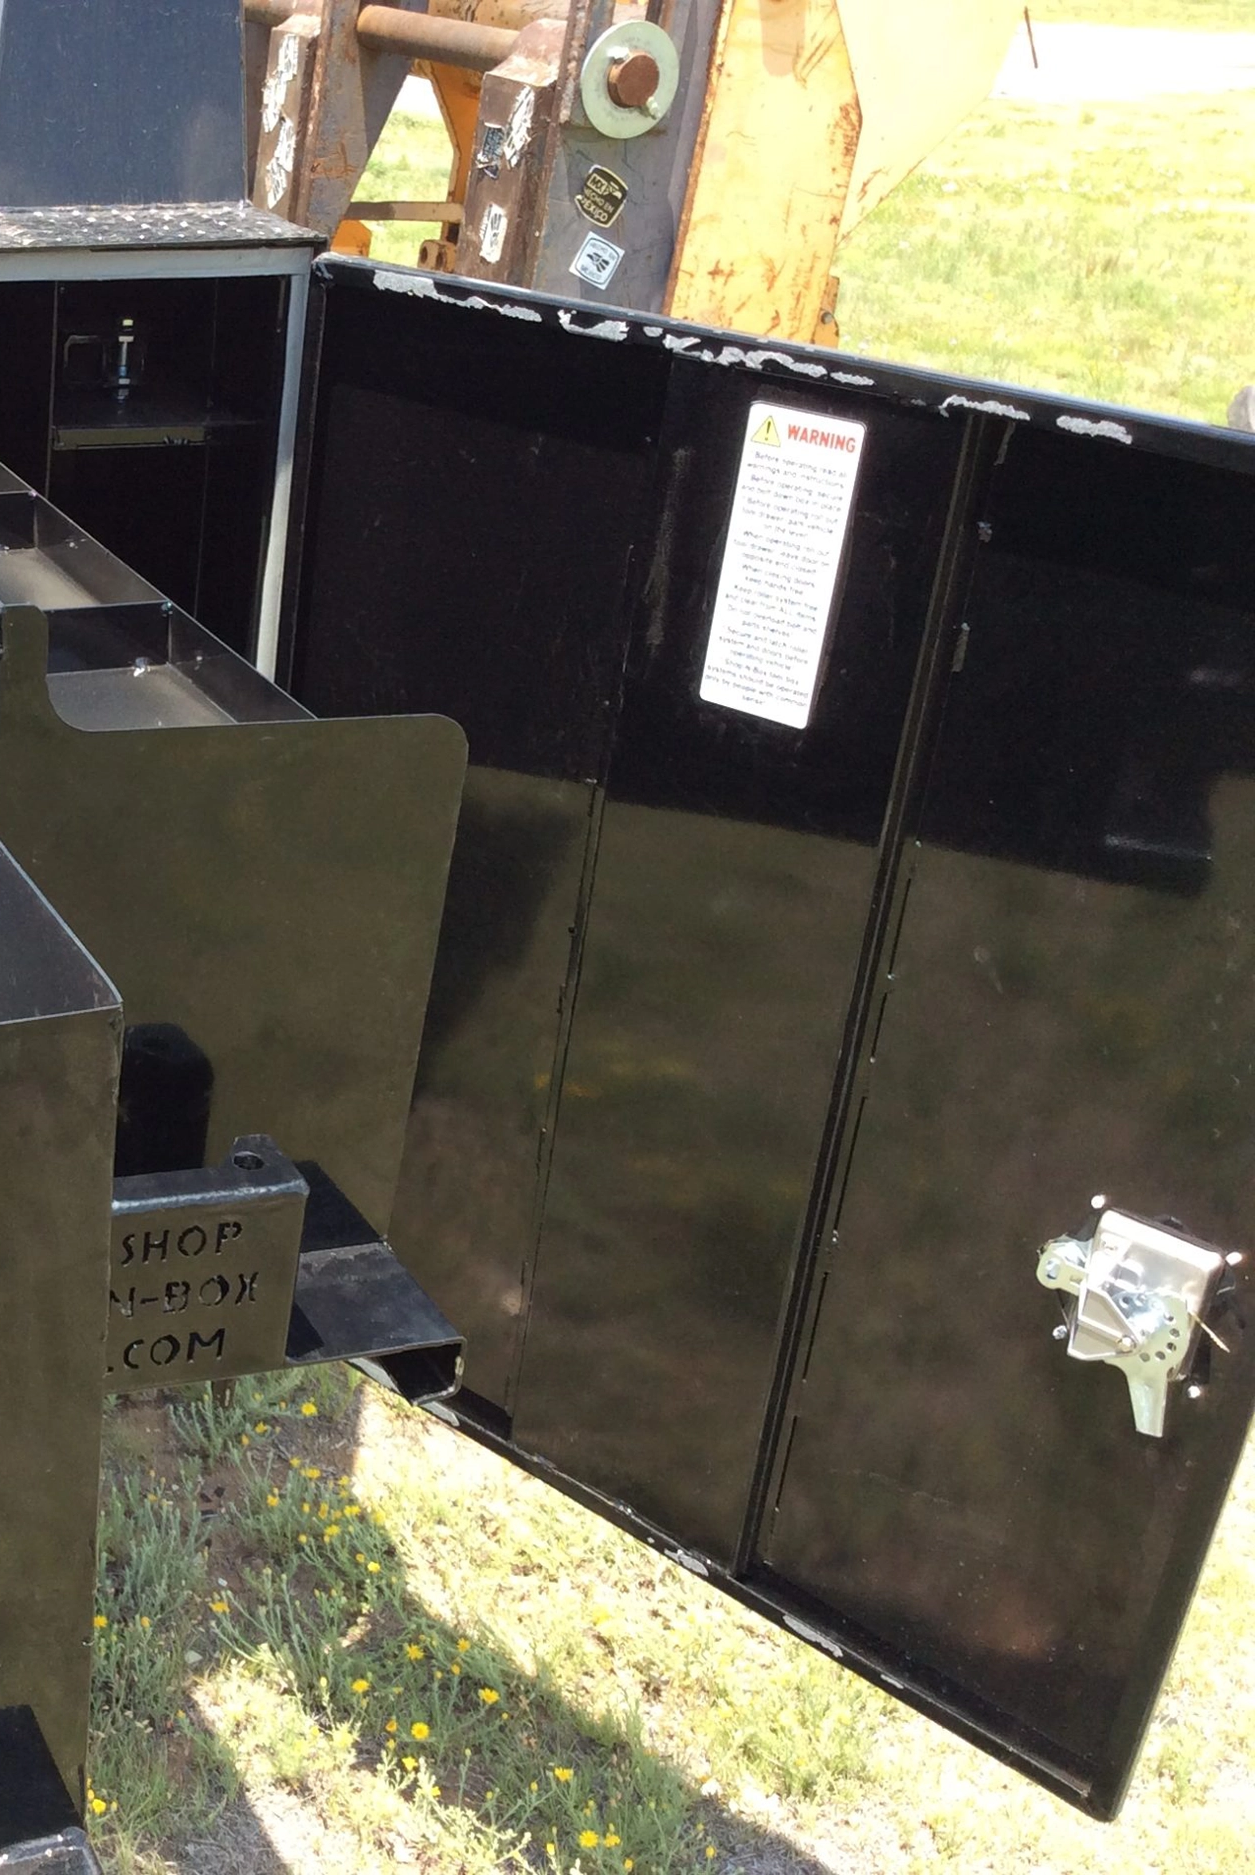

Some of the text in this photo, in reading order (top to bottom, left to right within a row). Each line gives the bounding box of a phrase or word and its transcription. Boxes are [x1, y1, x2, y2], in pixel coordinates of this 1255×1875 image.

[787, 423, 857, 454] WARNING
[121, 1221, 243, 1267] SHOP
[110, 1271, 259, 1319] N-BOX
